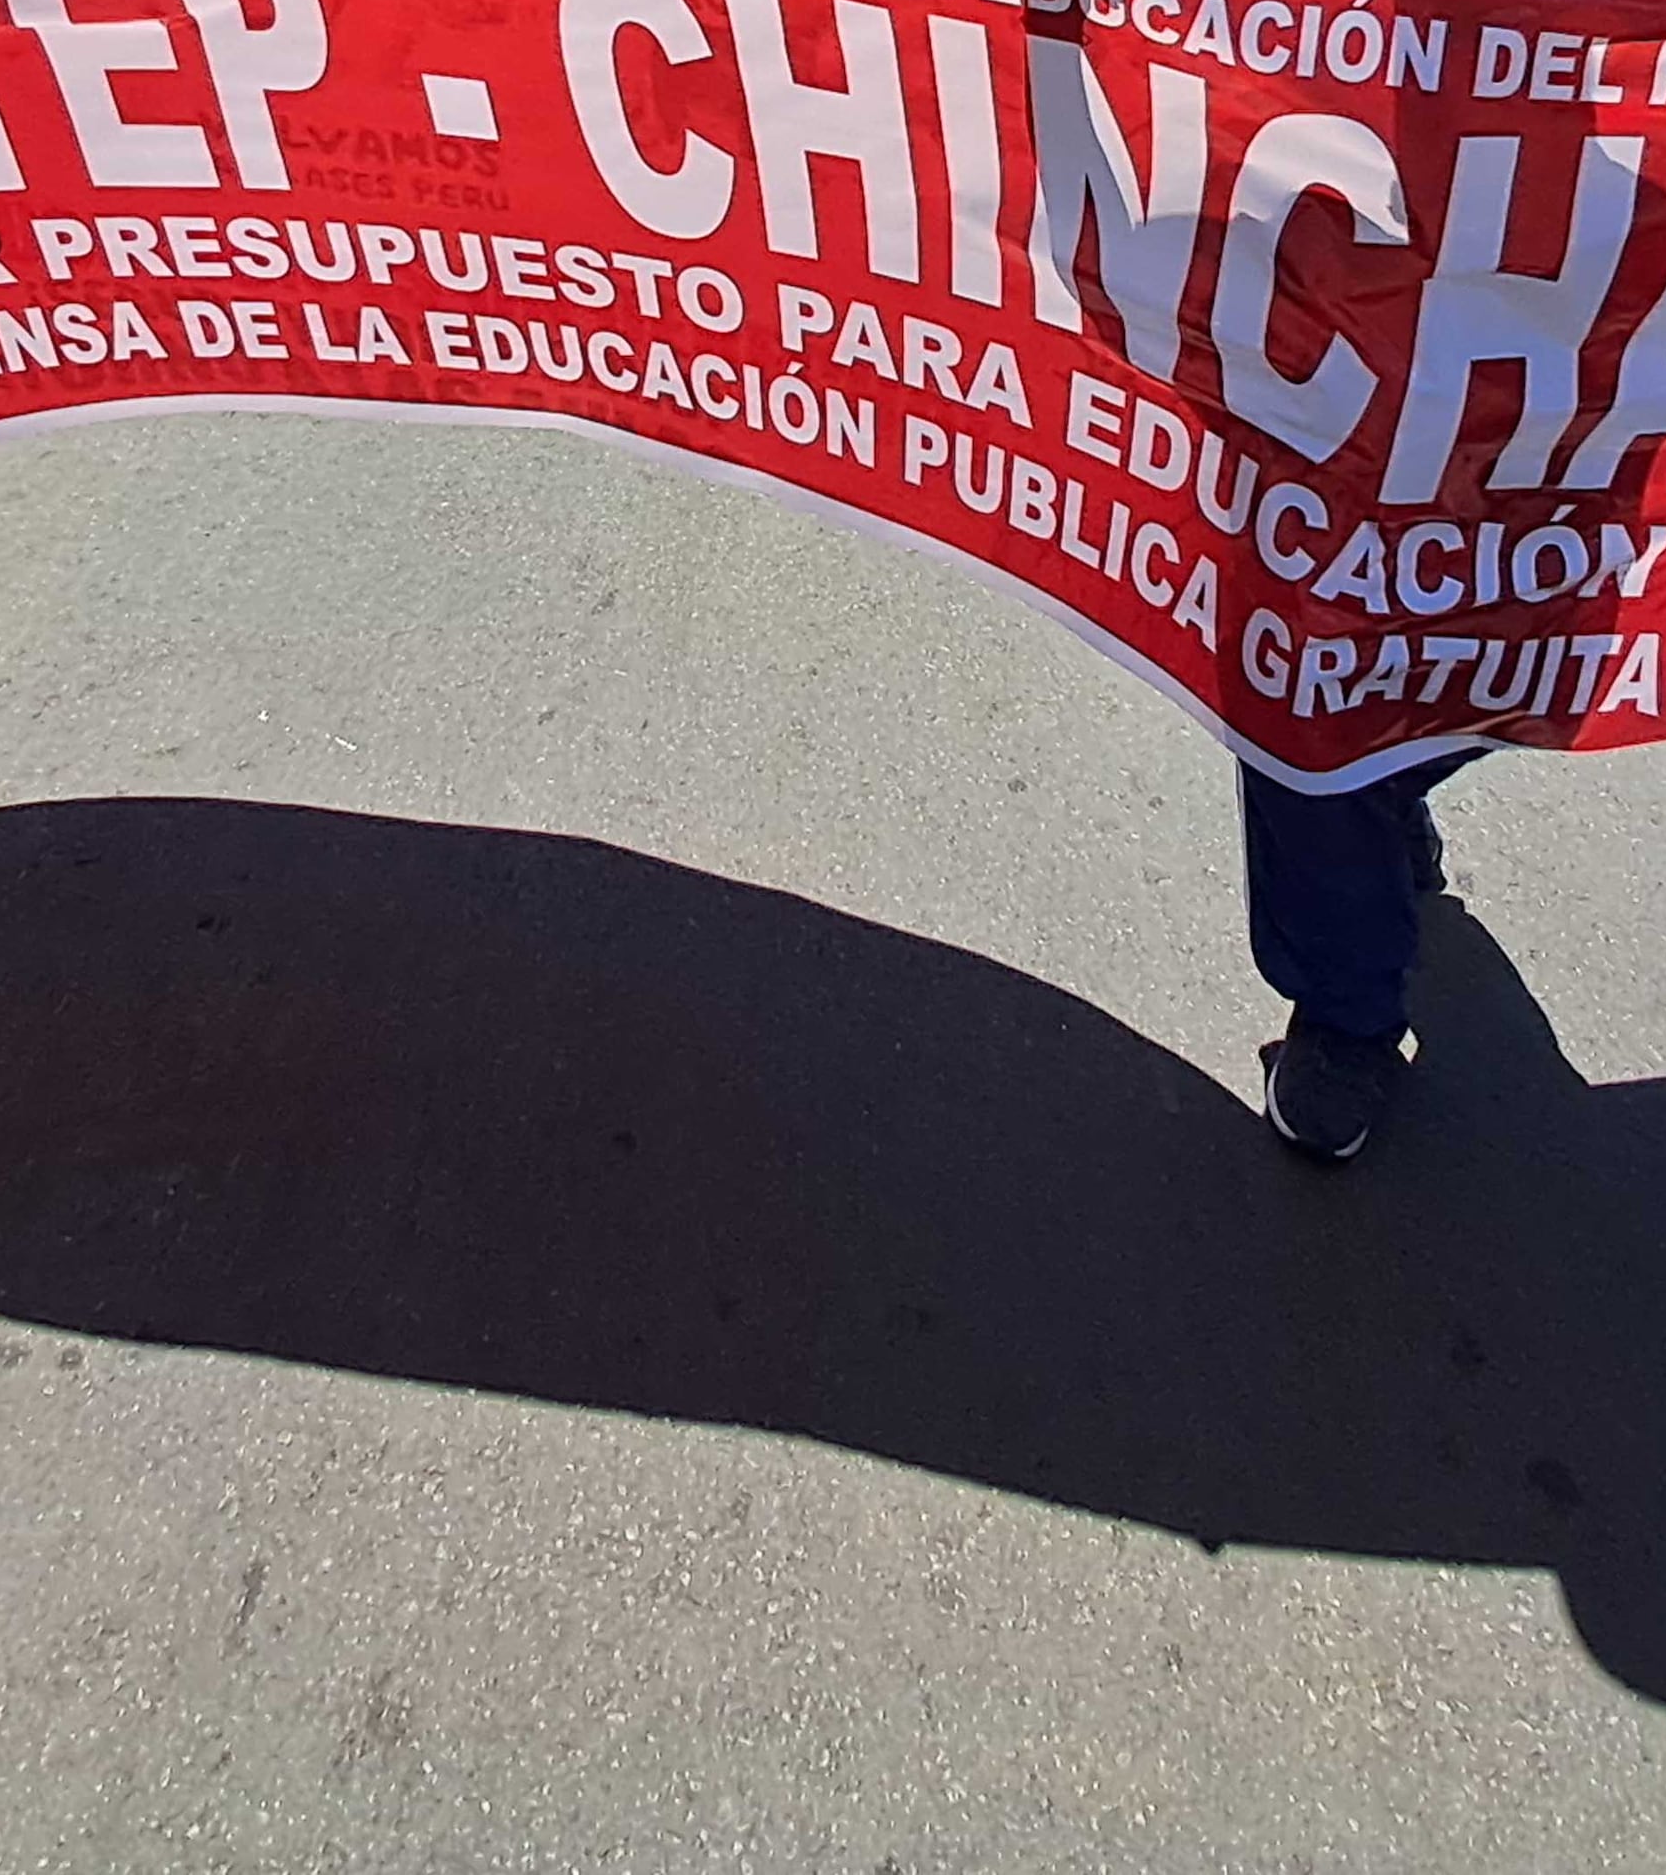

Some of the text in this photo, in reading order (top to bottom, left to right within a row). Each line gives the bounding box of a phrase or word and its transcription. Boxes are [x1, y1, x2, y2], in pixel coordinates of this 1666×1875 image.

[1472, 26, 1625, 104] DEL
[30, 215, 745, 333] PRESUPUESTO
[776, 283, 1034, 429] PARA
[177, 300, 291, 361] DE
[301, 301, 412, 367] LA
[424, 311, 877, 469] EDUCACIÓN
[903, 414, 1219, 655] PUBLICA
[1240, 607, 1661, 719] GRATUITA
